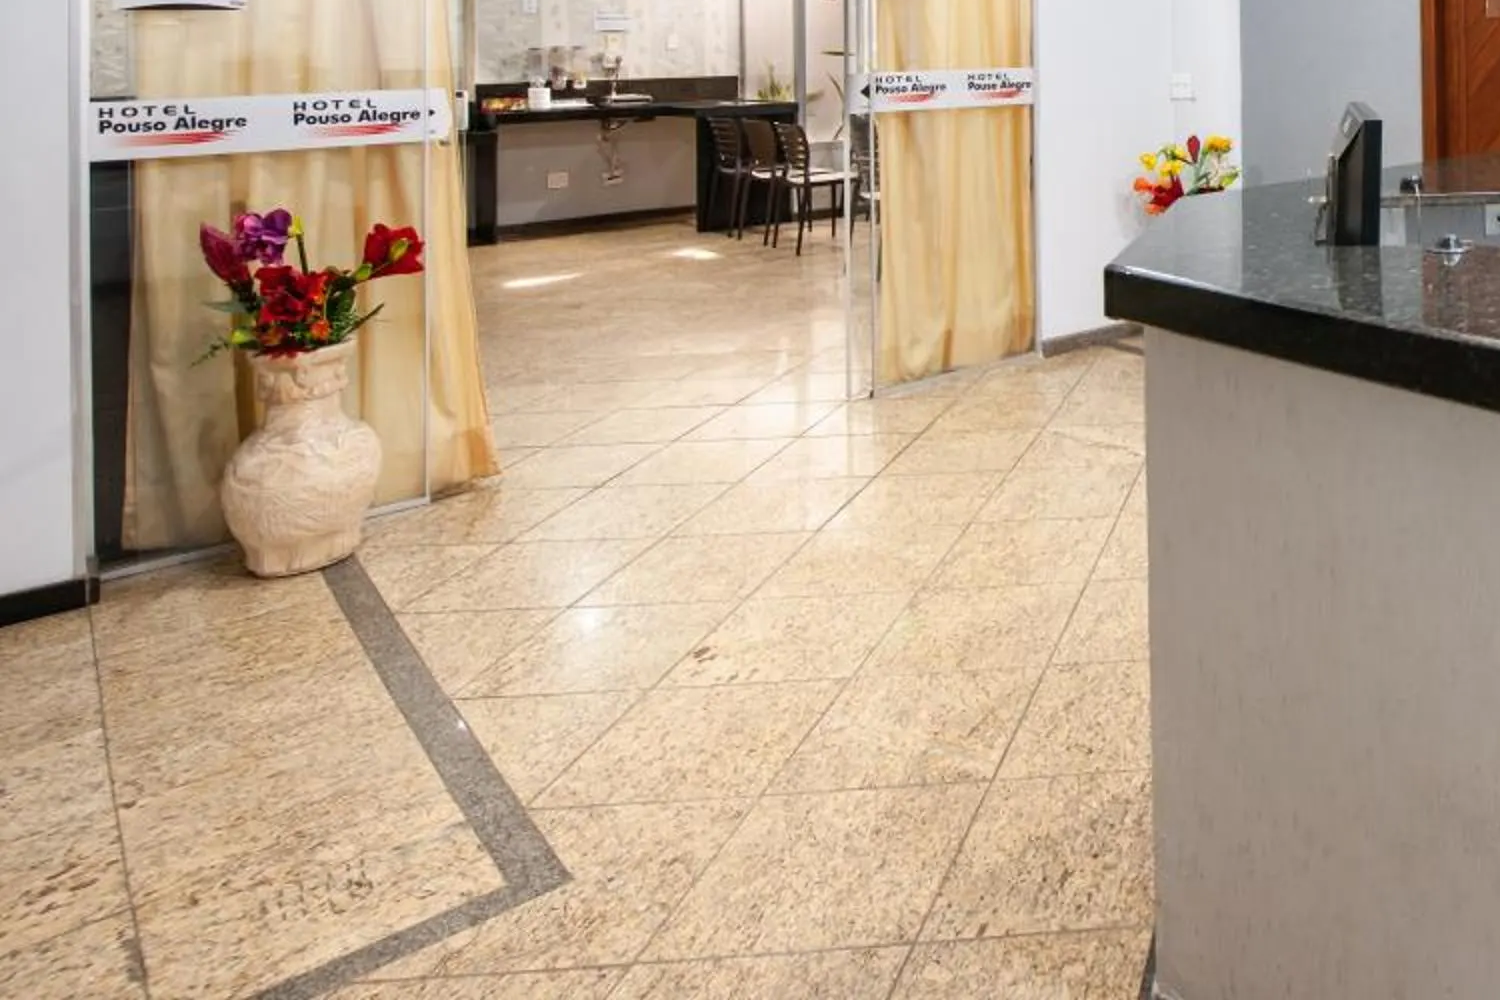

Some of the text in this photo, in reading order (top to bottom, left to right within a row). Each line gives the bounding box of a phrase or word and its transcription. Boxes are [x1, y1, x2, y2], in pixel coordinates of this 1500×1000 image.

[875, 75, 921, 84] HOTEL
[966, 73, 1011, 81] HOTEL
[875, 83, 947, 95] Pouso Alegre
[967, 80, 1032, 92] Pouso Alegre
[98, 104, 197, 119] HOTEL
[292, 98, 377, 112] HOTEL
[293, 109, 421, 126] Pouso Alegre
[99, 115, 247, 135] Pouso Alegre
